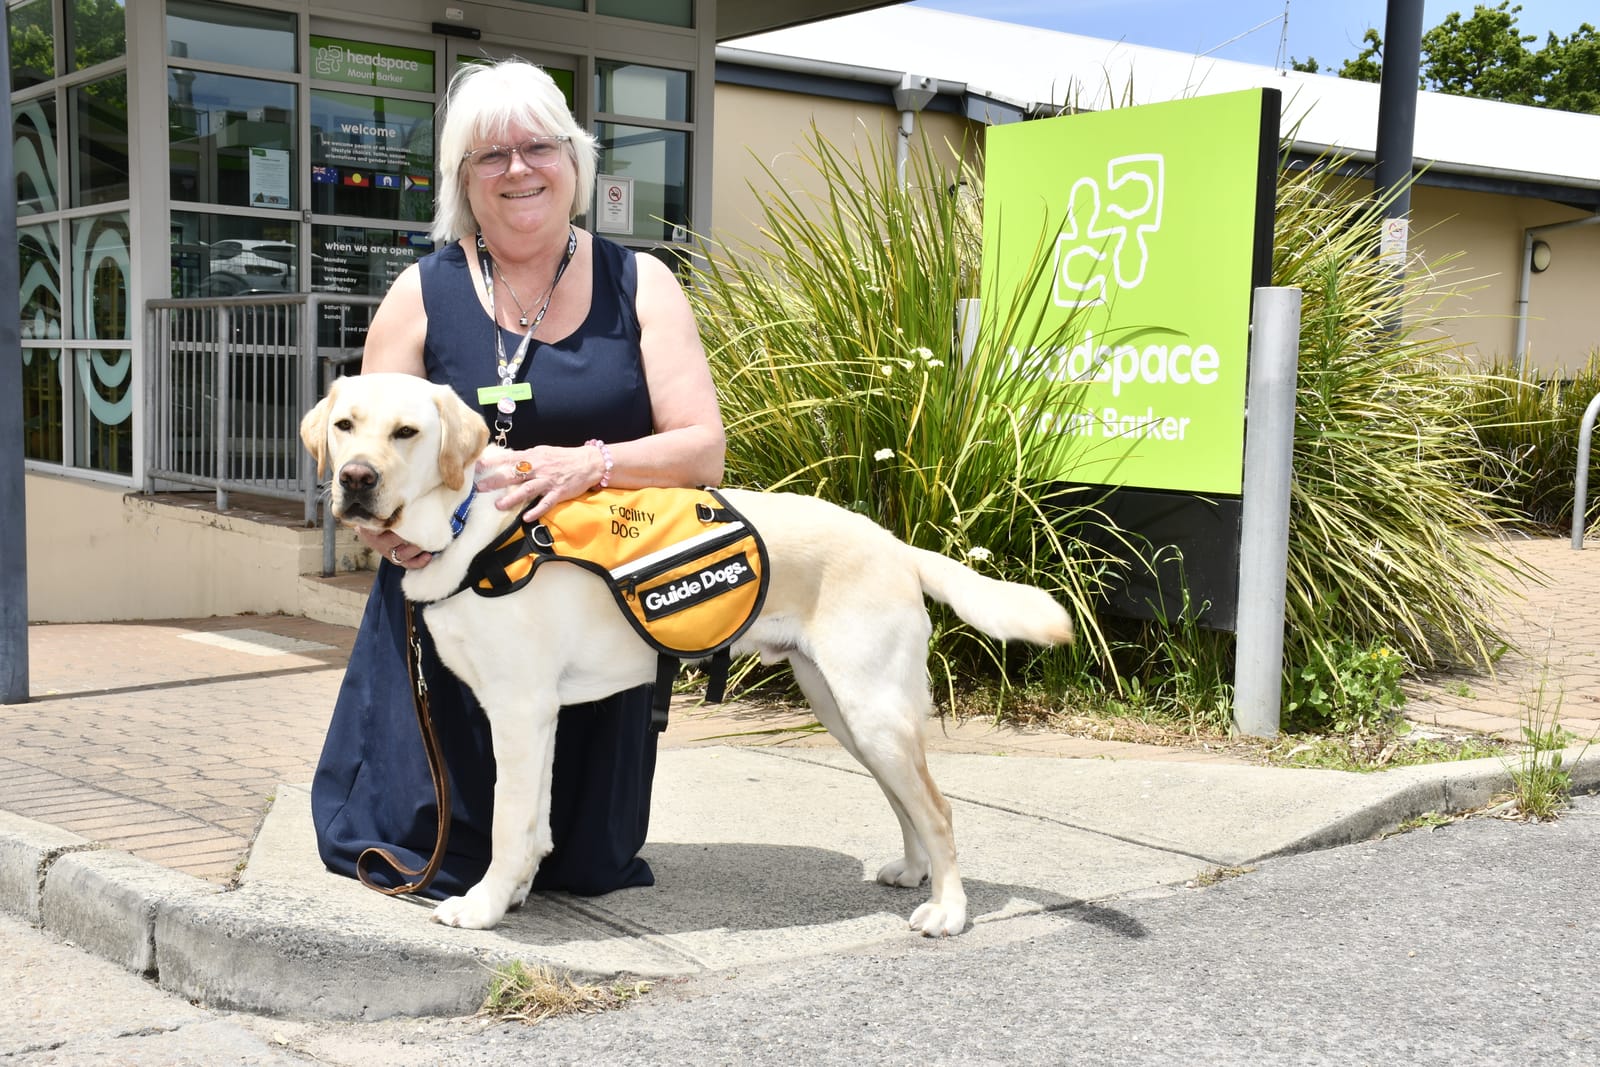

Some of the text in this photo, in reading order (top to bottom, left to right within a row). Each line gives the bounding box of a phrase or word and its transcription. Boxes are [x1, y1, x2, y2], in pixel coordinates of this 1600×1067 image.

[347, 49, 418, 71] headspace
[347, 69, 403, 83] Mount Barker
[341, 124, 396, 138] welcome
[325, 242, 414, 256] when we are open
[323, 266, 349, 274] Tuesday
[323, 276, 357, 284] Wednesday
[1102, 406, 1191, 441] Barker
[609, 504, 655, 525] Facility
[611, 520, 640, 538] DOG
[645, 562, 747, 610] Guide Dogs.
